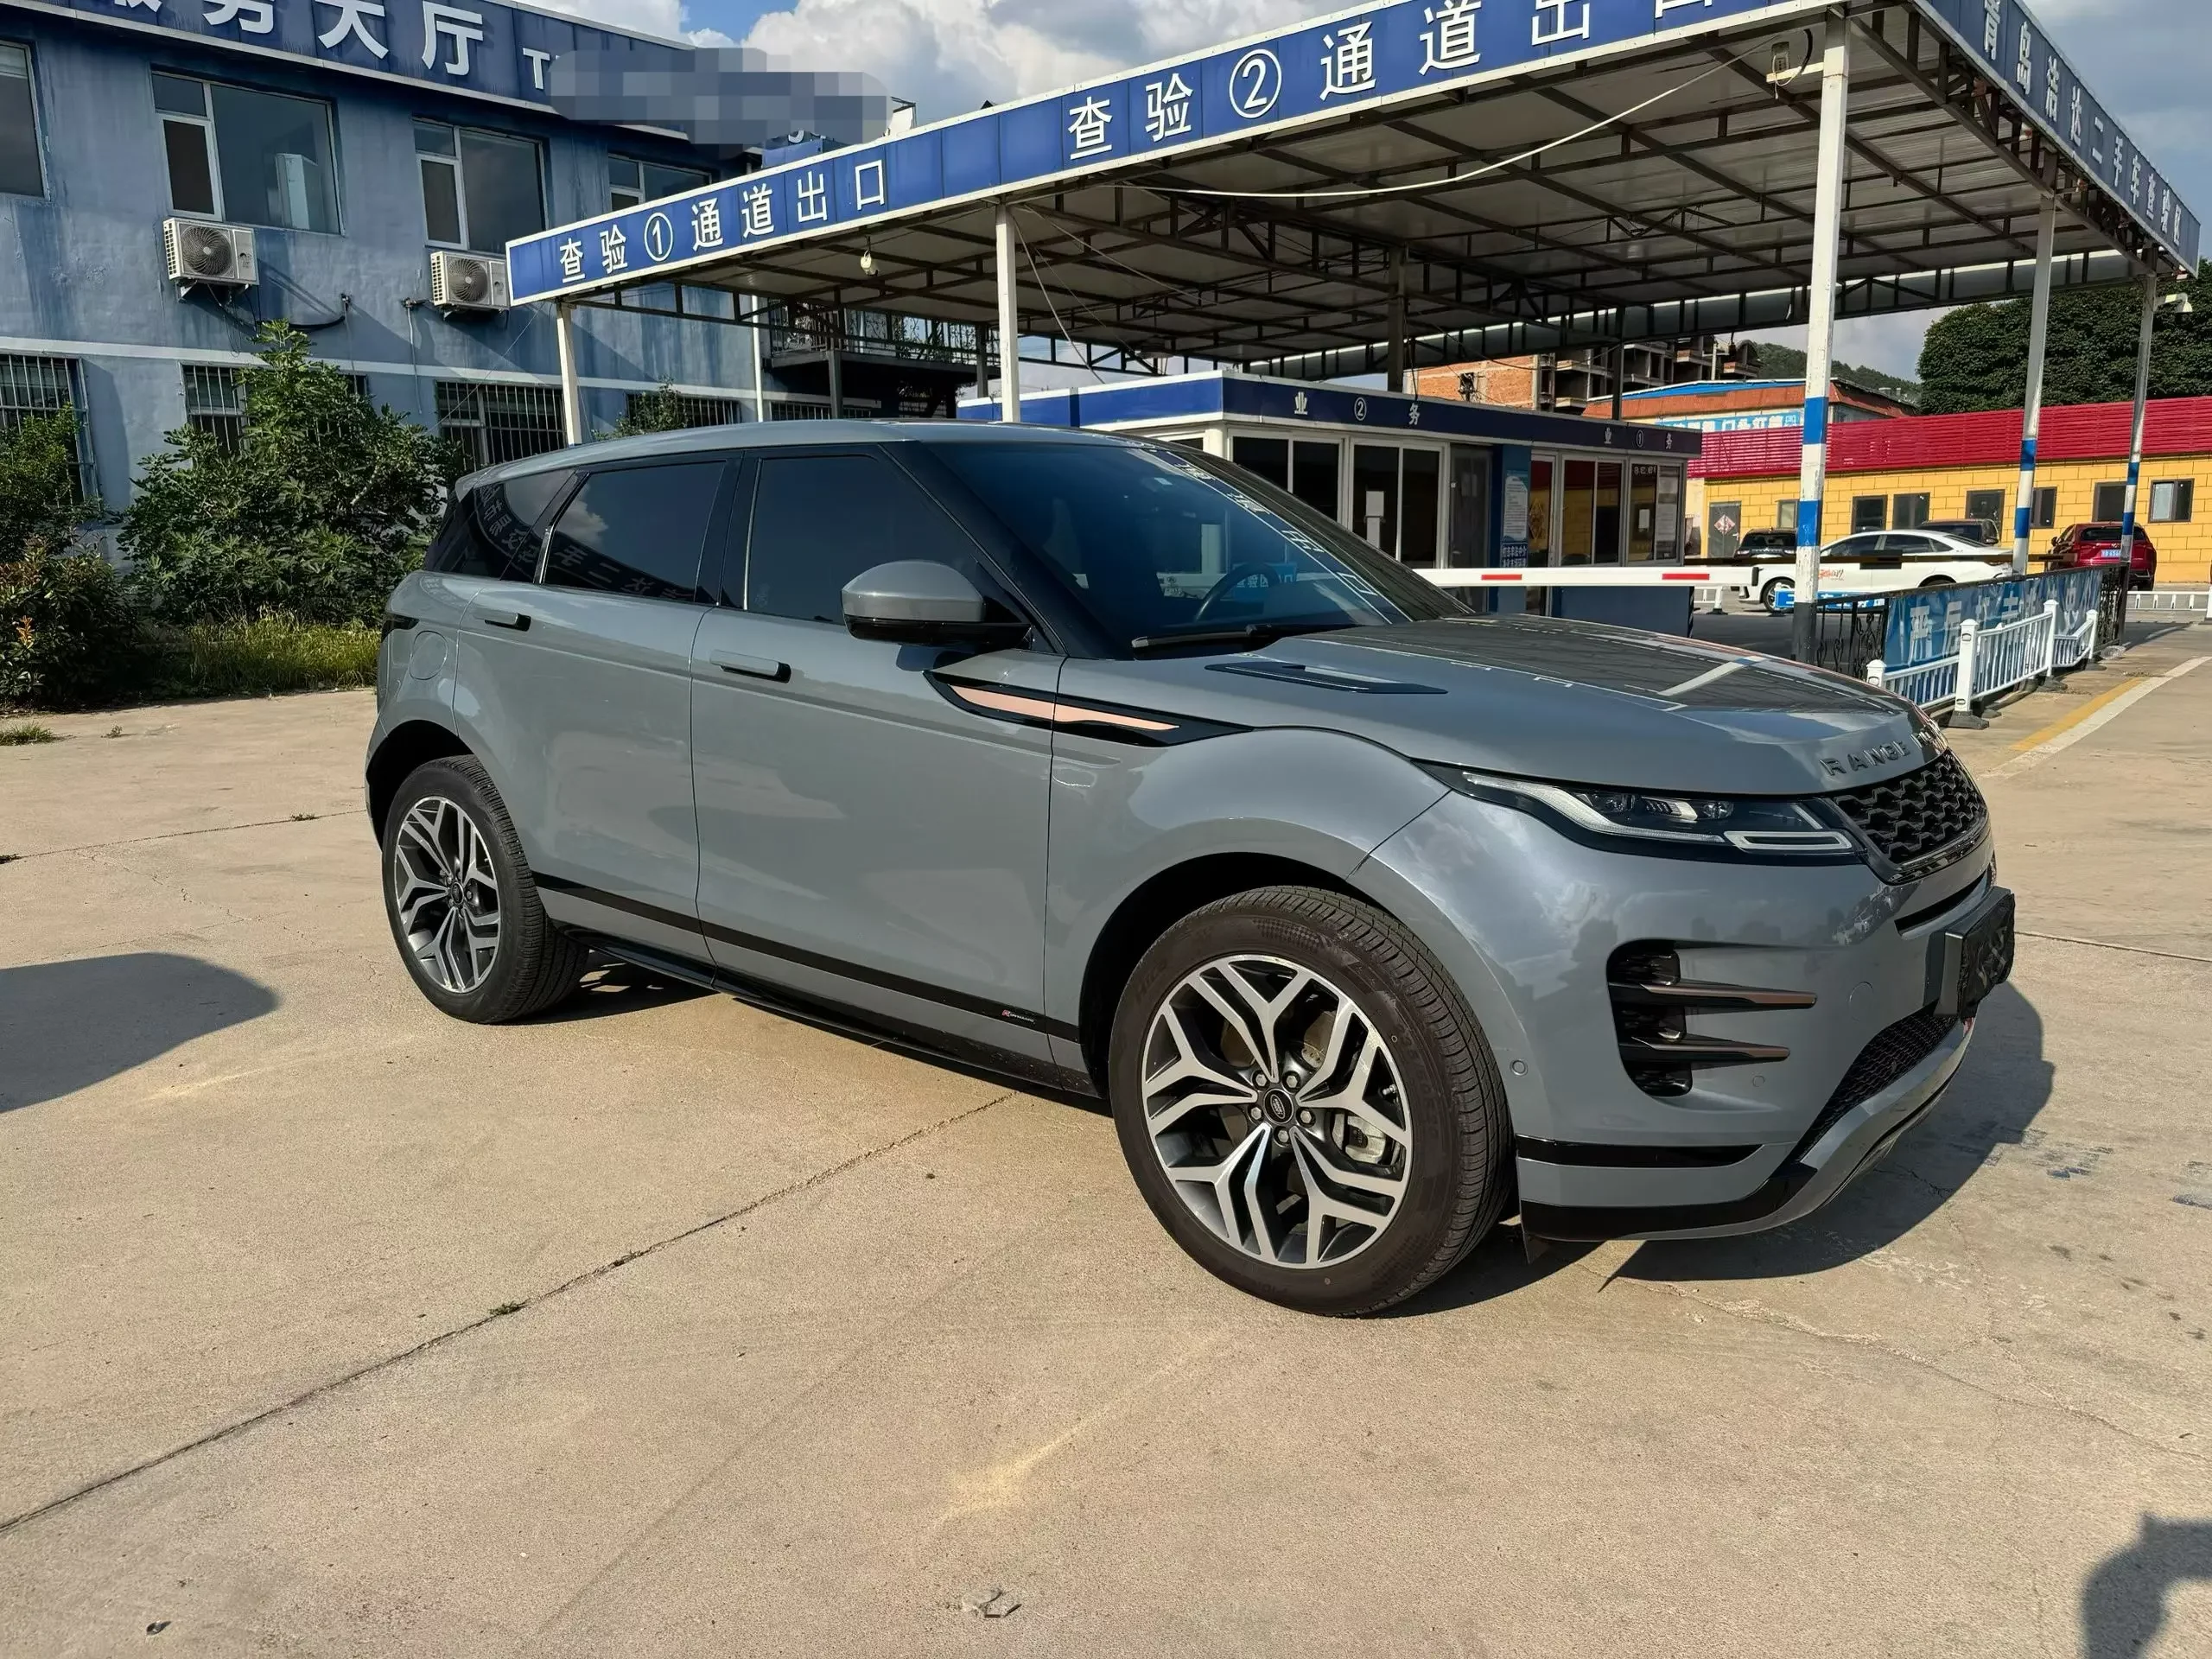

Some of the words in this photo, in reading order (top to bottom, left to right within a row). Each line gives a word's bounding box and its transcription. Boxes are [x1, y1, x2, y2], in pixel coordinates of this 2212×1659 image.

[113, 0, 484, 76] 大厅
[1068, 0, 1714, 159] 查验②通道出
[559, 159, 886, 283] 查验①通道出口
